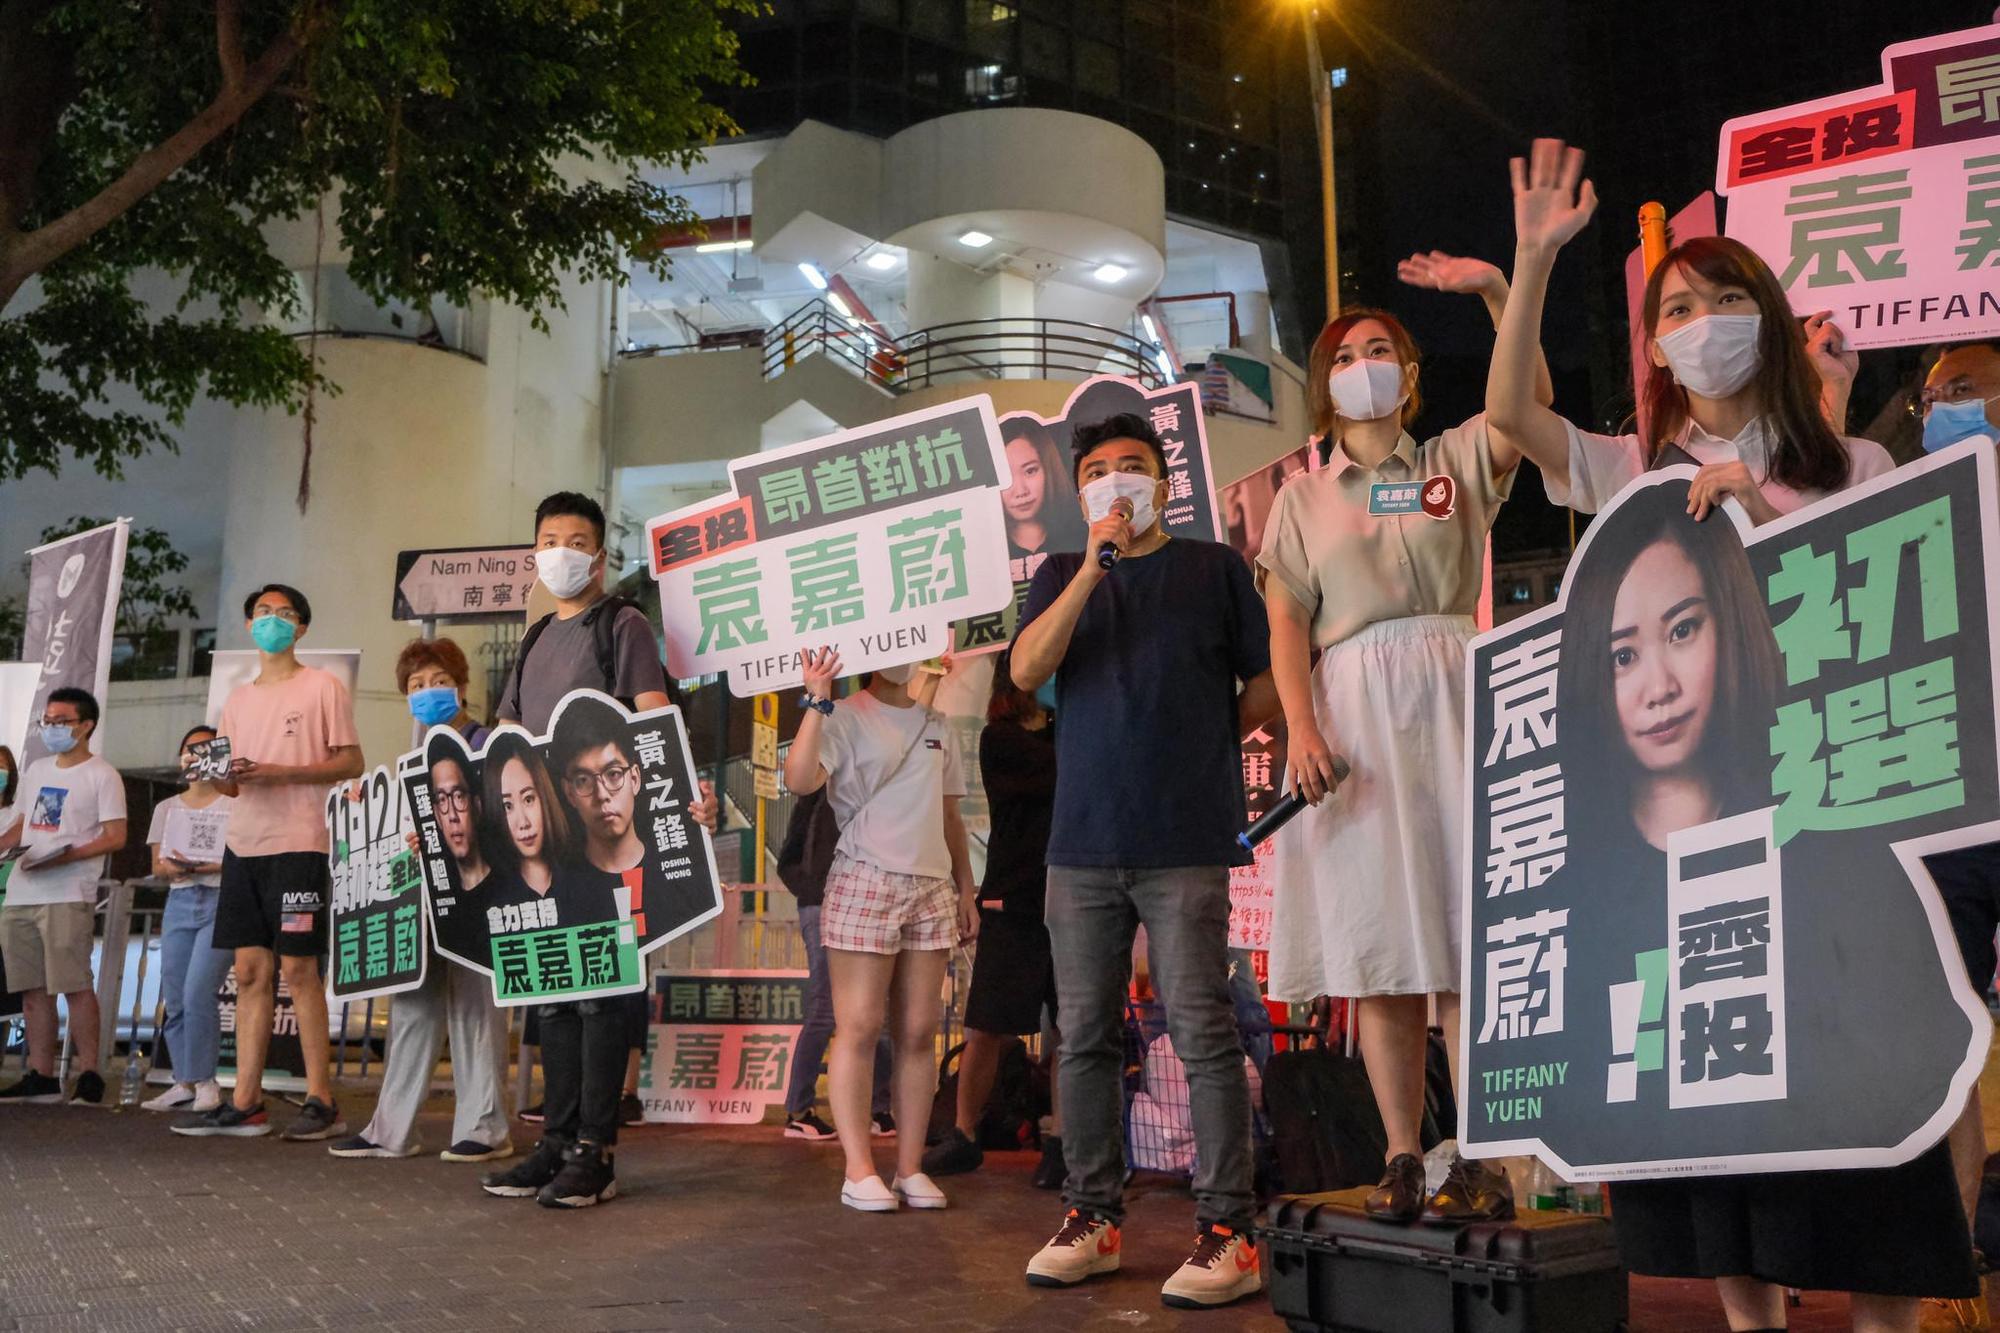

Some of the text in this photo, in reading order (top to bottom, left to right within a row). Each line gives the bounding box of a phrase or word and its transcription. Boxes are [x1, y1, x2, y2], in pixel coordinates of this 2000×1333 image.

[1738, 103, 1902, 179] 全投
[758, 427, 974, 526] 昂首對抗
[1164, 504, 1194, 519] JOSHUA
[1167, 514, 1194, 527] WONG
[658, 506, 748, 567] 全投
[431, 555, 535, 576] Nam Ning S
[692, 507, 970, 656] 袁嘉蔚
[860, 624, 928, 656] YUEN
[634, 730, 689, 853] 黃之鋒
[1477, 629, 1570, 1045] 袁嘉蔚
[660, 856, 692, 872] JOSHUA
[664, 868, 692, 880] WONG
[282, 891, 320, 904] NASA
[338, 904, 418, 985] 袁嘉蔚
[498, 924, 621, 994] 袁嘉蔚
[1679, 836, 1774, 1084] 一齊投
[670, 983, 804, 1020] 昂首對抗
[1482, 1061, 1569, 1094] TIFFANY
[643, 1098, 752, 1114] FFANY YUEN
[1485, 1096, 1542, 1124] YUEN
